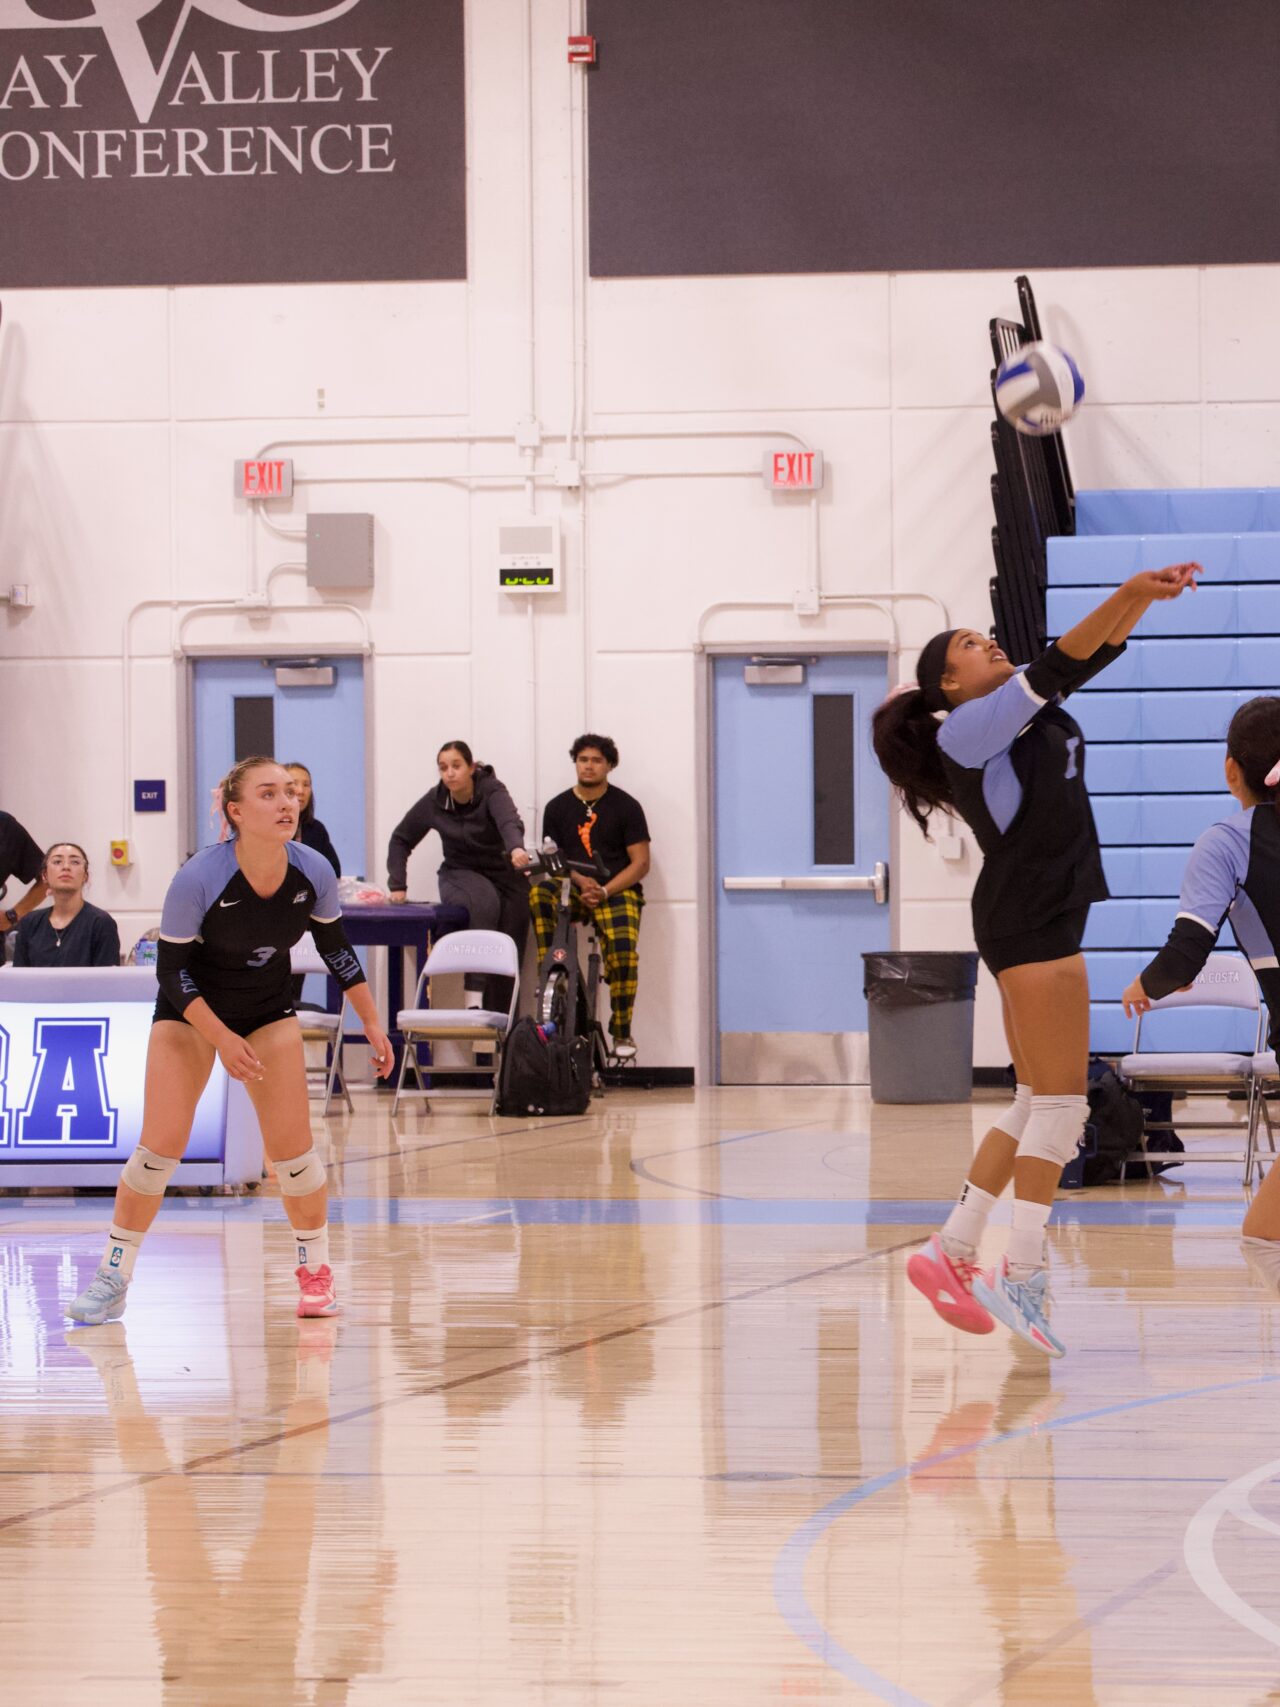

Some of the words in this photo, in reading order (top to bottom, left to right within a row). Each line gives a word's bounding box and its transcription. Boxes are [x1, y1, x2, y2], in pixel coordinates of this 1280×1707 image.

[0, 54, 97, 109] AY
[0, 123, 397, 181] ONFERENCE
[243, 461, 285, 495] EXIT
[773, 452, 815, 486] EXIT
[1064, 736, 1079, 779] 1
[141, 791, 159, 800] EXIT
[246, 946, 277, 968] 3
[1208, 971, 1240, 984] COSTA
